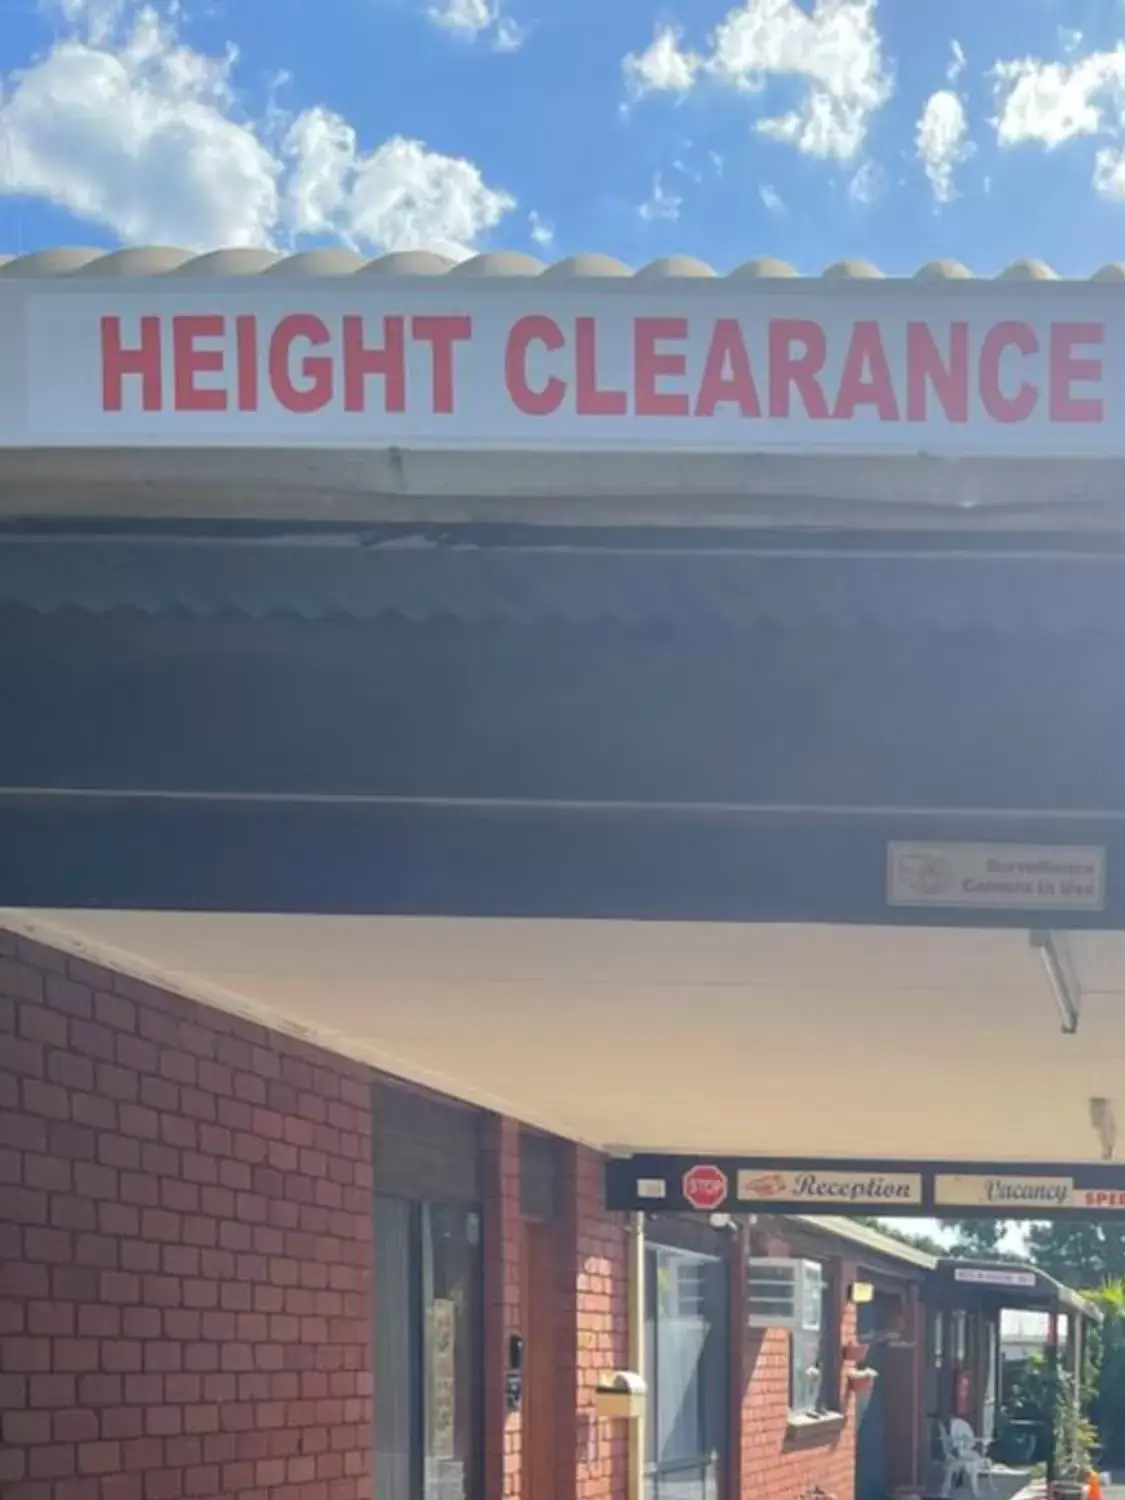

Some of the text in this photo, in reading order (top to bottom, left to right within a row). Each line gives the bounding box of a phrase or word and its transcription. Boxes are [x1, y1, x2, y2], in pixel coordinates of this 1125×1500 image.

[101, 313, 471, 413] HEIGHT
[505, 315, 1106, 424] CLEARANCE
[690, 1178, 724, 1196] STOP
[792, 1173, 912, 1200] Reception
[983, 1179, 1069, 1204] Vacancy
